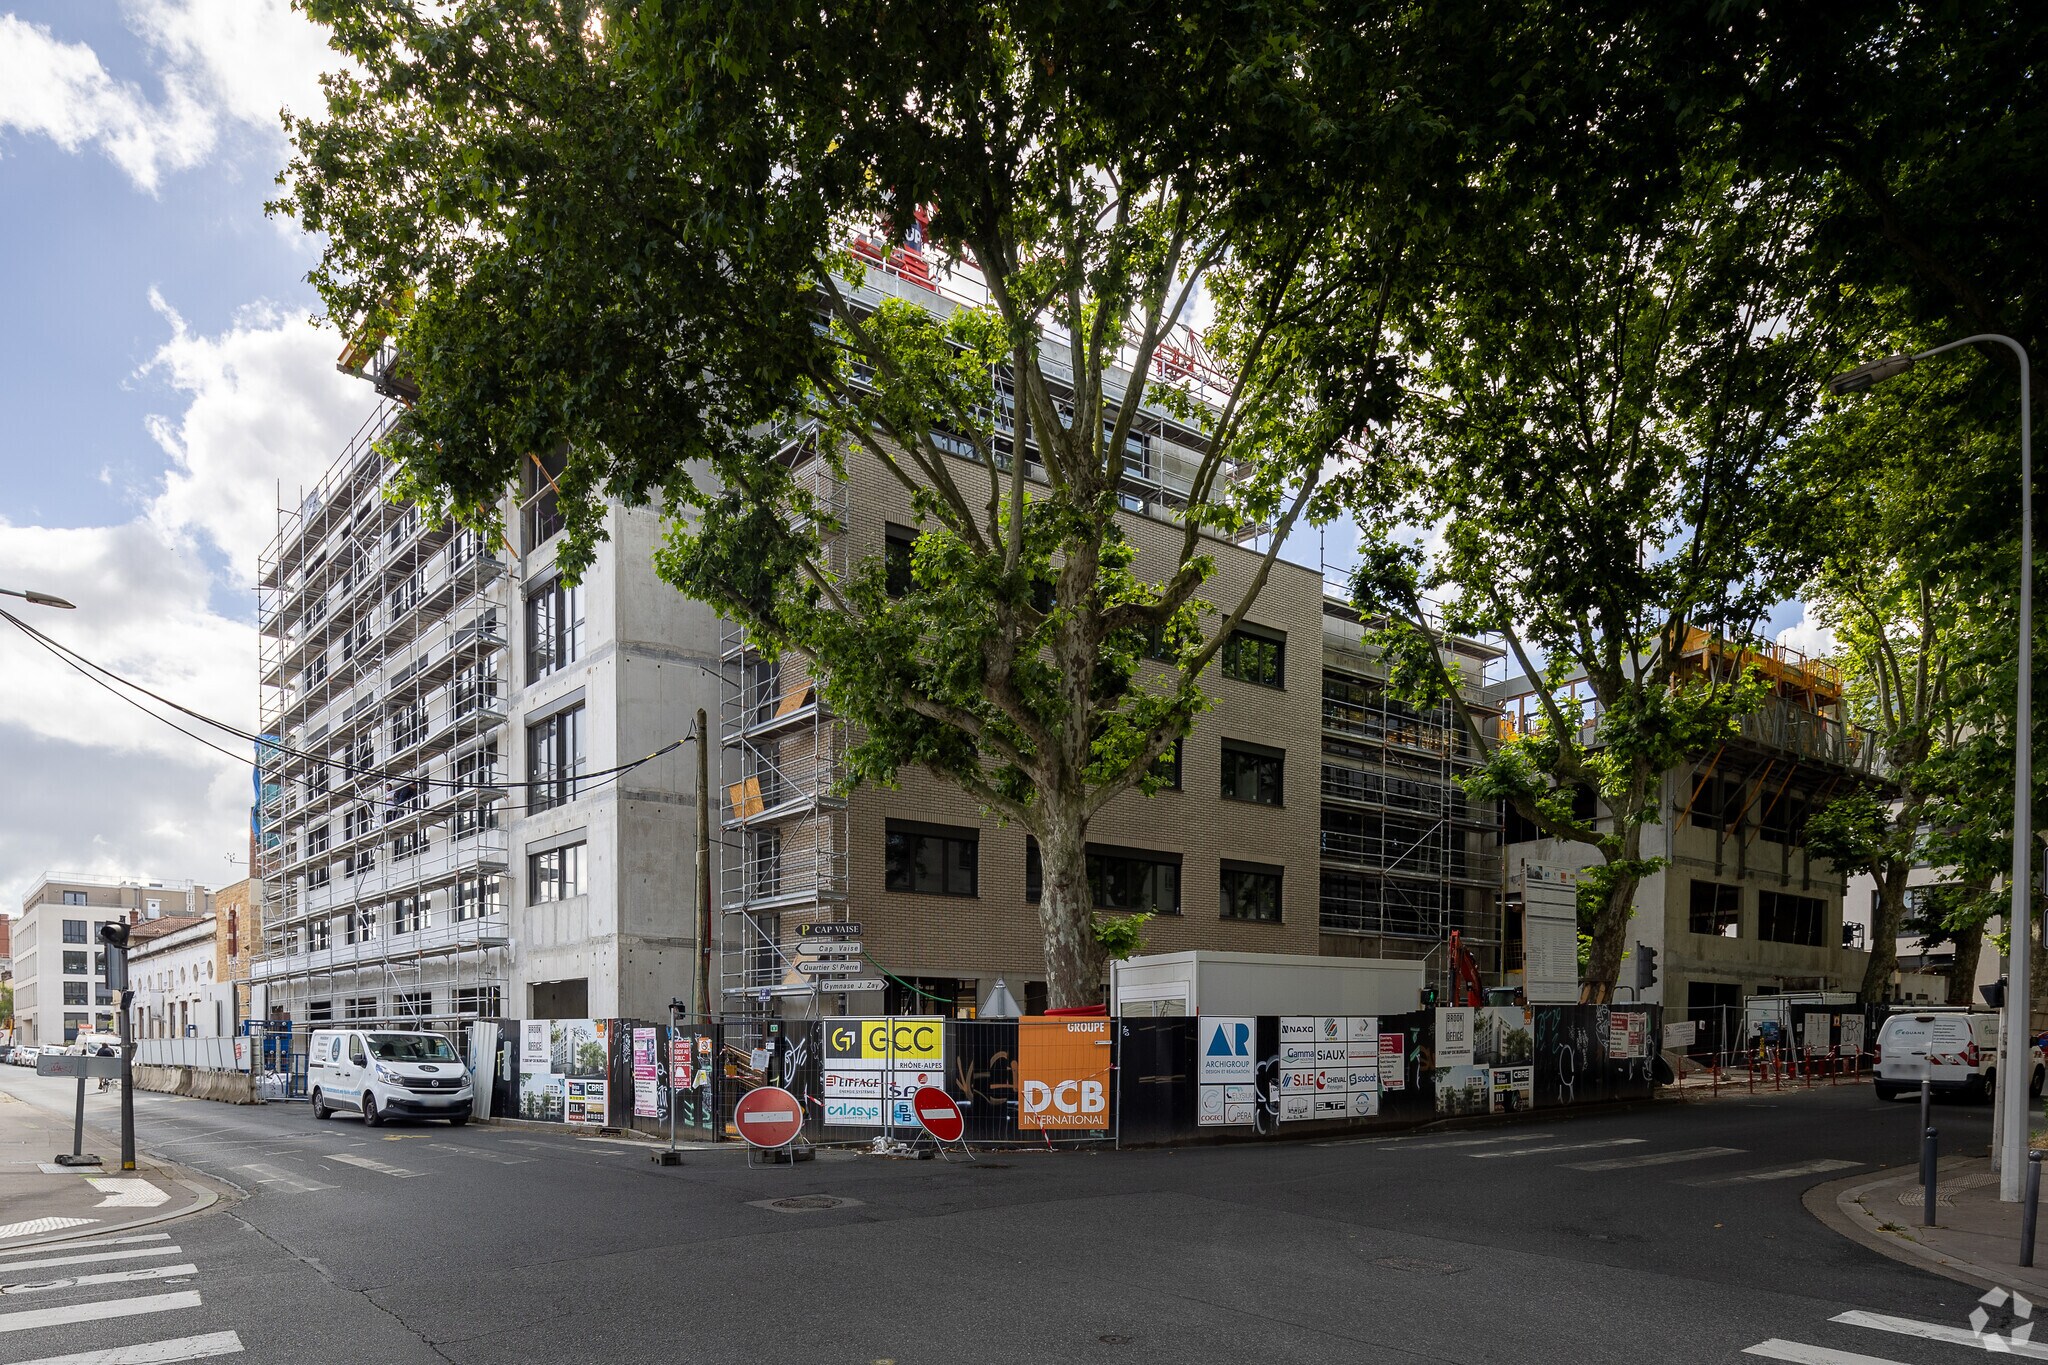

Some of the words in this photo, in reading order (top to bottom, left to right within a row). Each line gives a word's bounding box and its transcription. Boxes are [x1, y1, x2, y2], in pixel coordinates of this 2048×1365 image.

[802, 925, 810, 935] P
[1068, 1023, 1104, 1032] GROUPE
[870, 1027, 934, 1052] GCC
[1288, 1048, 1314, 1058] Gamma
[1317, 1050, 1345, 1060] SiAUX
[839, 1079, 878, 1087] EIFFAGE
[1024, 1080, 1105, 1113] DCB
[1316, 1102, 1345, 1111] SLTP
[1024, 1115, 1103, 1124] INTERNATIONAL
